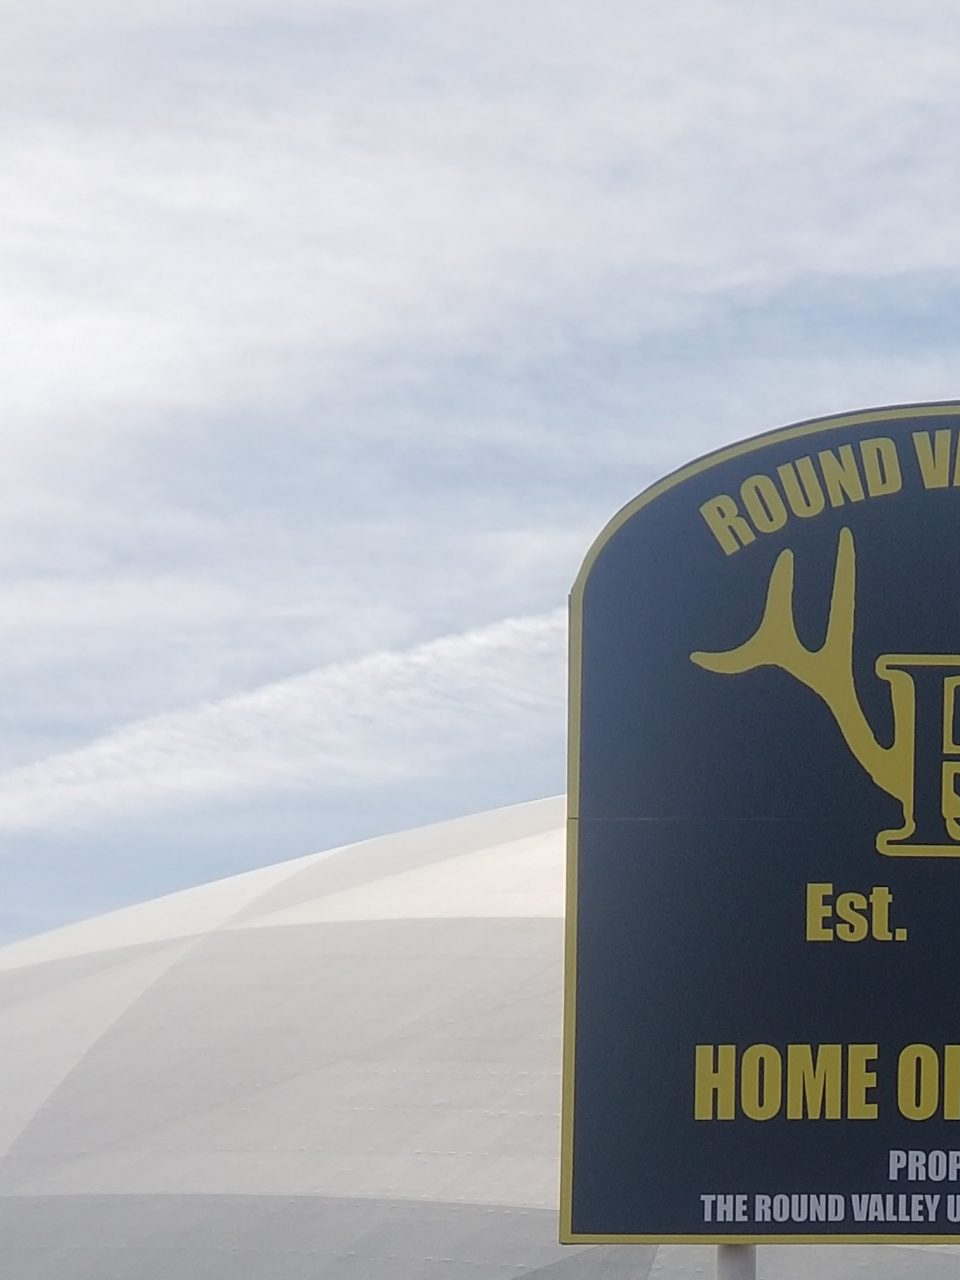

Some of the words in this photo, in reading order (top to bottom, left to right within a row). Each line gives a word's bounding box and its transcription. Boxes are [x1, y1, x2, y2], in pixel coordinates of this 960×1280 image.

[699, 437, 902, 556] ROUND
[806, 883, 908, 942] Est.
[694, 1043, 879, 1121] HOME
[699, 1194, 749, 1222] THE
[754, 1193, 845, 1223] ROUND
[850, 1194, 941, 1222] VALLEY
